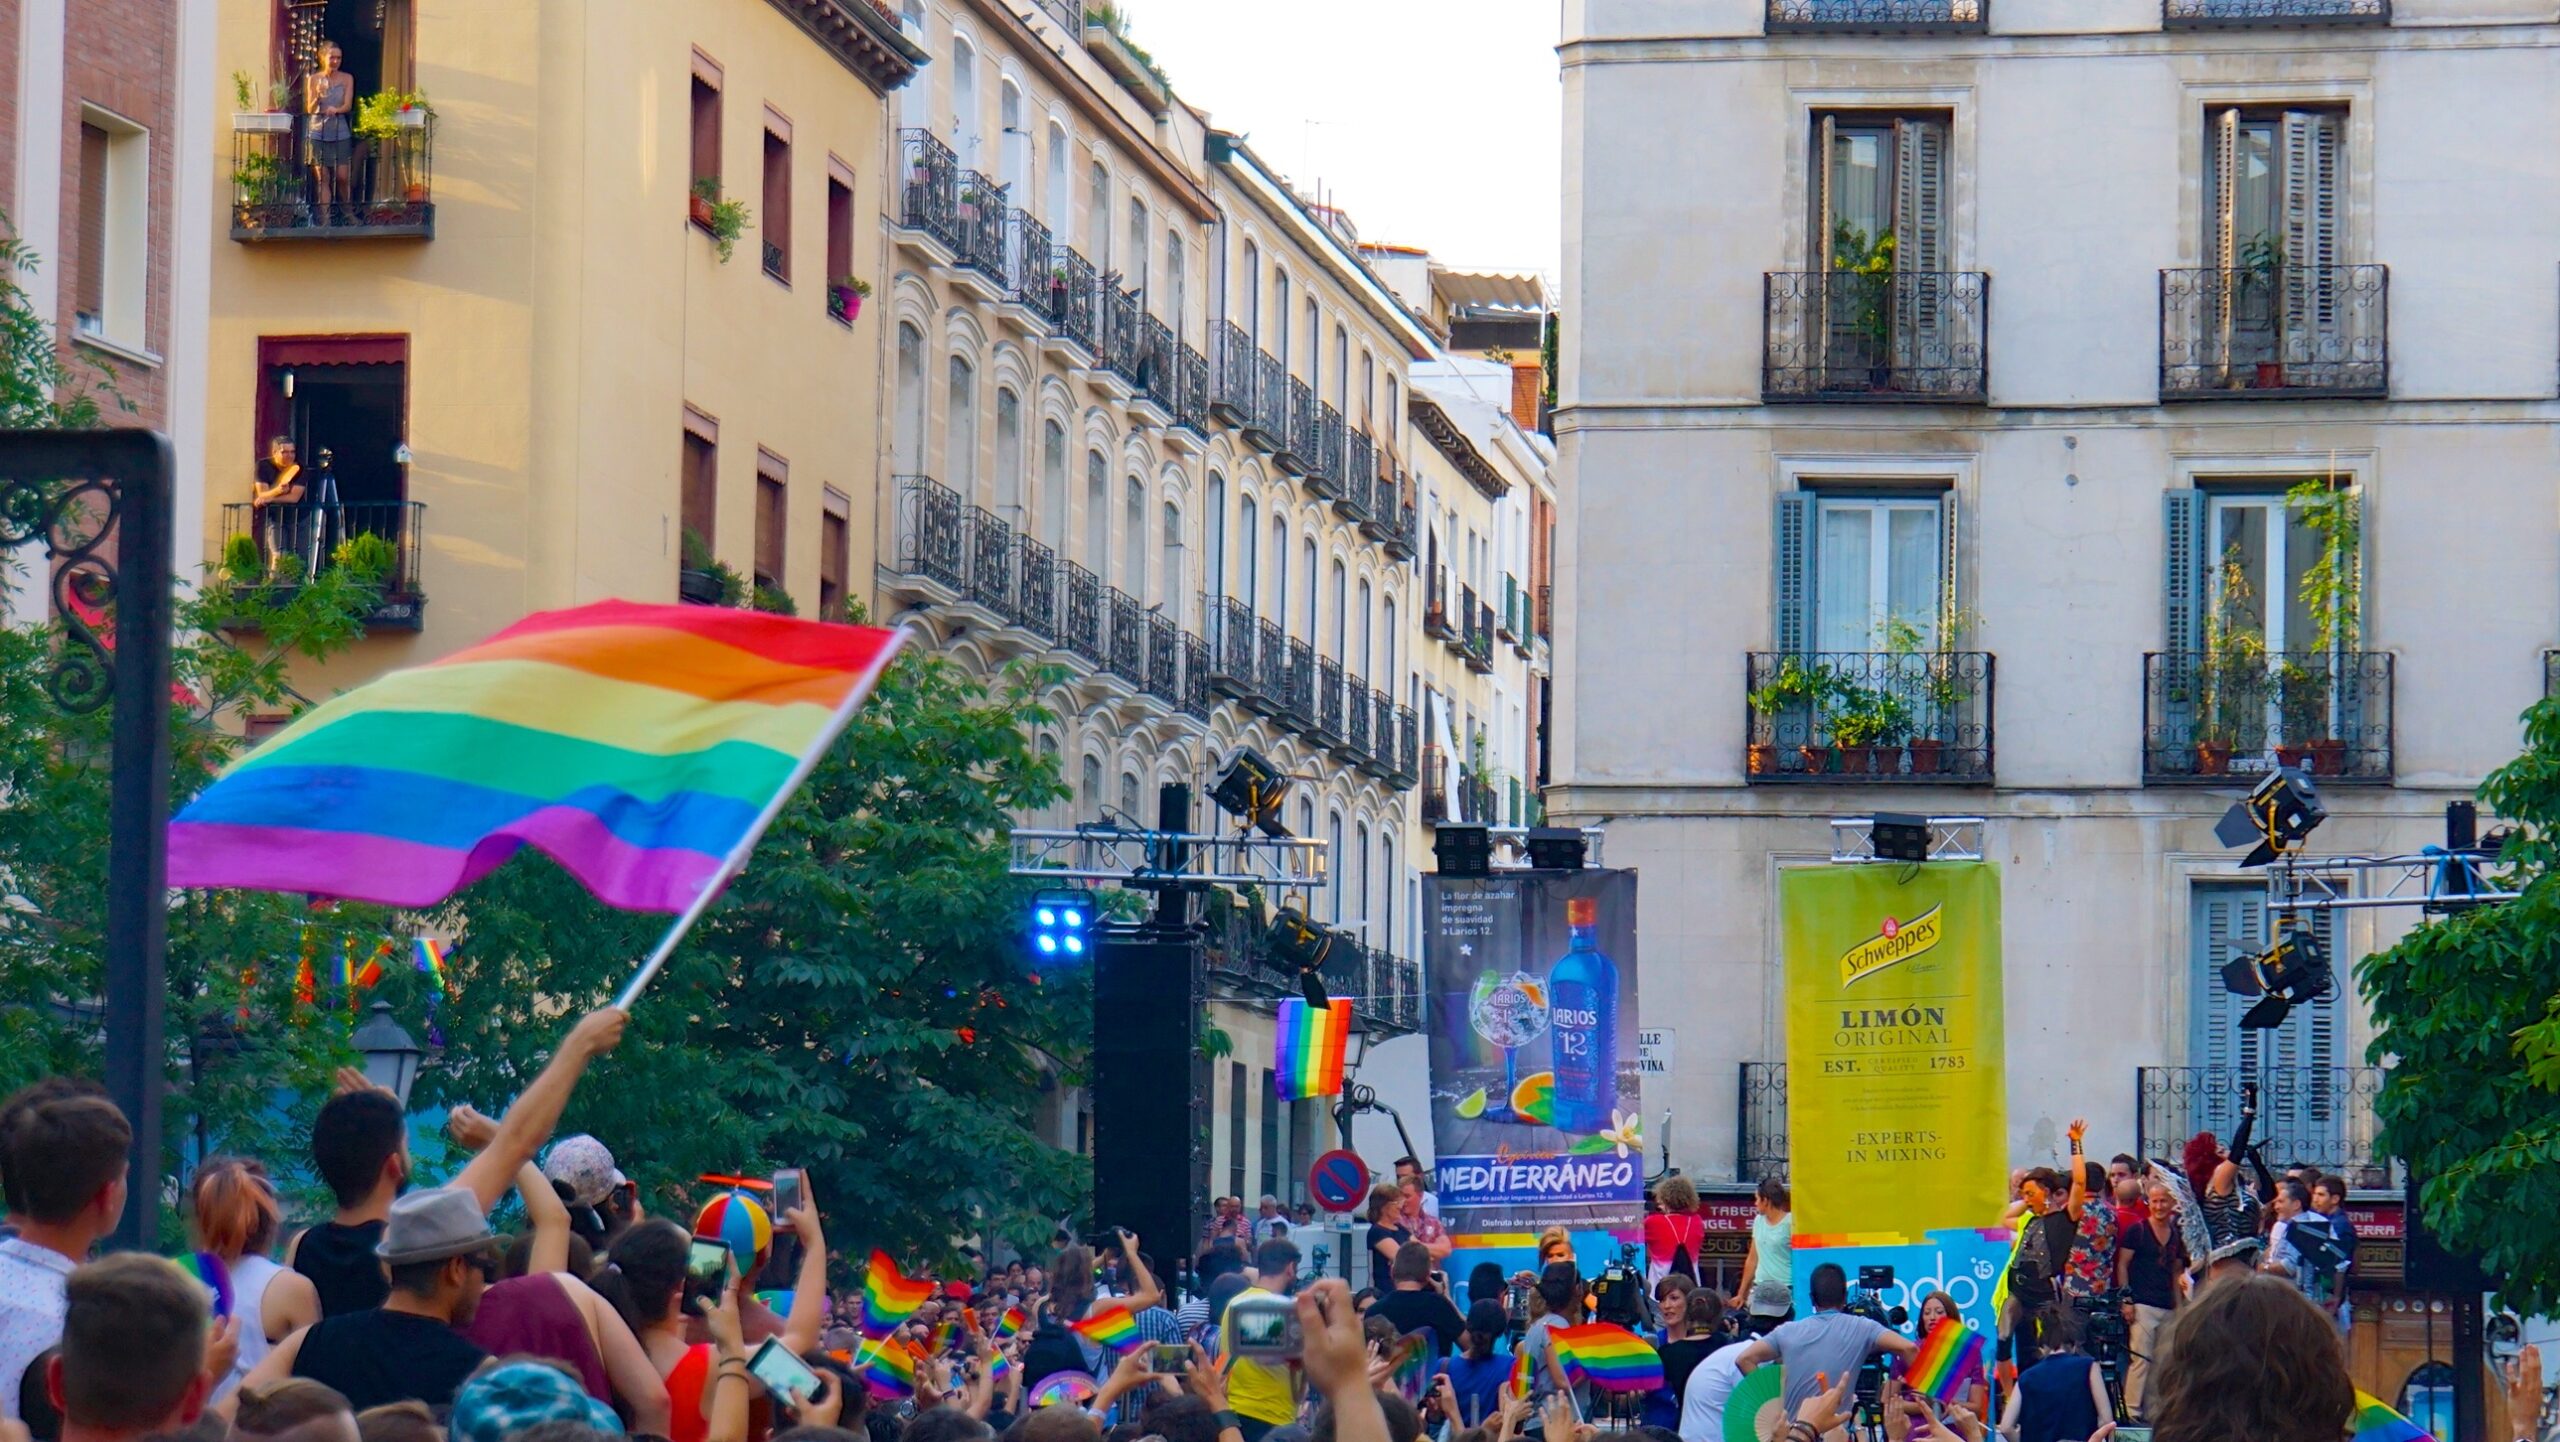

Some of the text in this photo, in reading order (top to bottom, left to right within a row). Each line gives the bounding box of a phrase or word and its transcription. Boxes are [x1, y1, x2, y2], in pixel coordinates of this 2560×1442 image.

[1441, 891, 1452, 900] La
[1472, 891, 1483, 900] de
[1484, 890, 1516, 900] azahar
[1441, 903, 1484, 914] impregna
[1441, 914, 1494, 924] de suavidad
[1450, 926, 1478, 935] Larios
[1847, 919, 1935, 977] Schweppes
[1494, 993, 1526, 1006] LARIOS
[1552, 1007, 1598, 1028] LARIOS
[1840, 1003, 1945, 1029] LIMÓN
[1558, 1032, 1588, 1056] 12
[1640, 1033, 1661, 1045] LLE
[1834, 1028, 1952, 1048] ORIGINAL
[1640, 1060, 1664, 1072] VINA
[1824, 1056, 1966, 1072] EST. 1783
[1847, 1148, 1946, 1162] IN MIXING
[1440, 1157, 1633, 1192] MEDITERRÁNEO
[1710, 1206, 1760, 1216] TABER
[1482, 1218, 1512, 1227] Disfruta
[1514, 1218, 1524, 1226] de
[1536, 1218, 1572, 1226] consumo
[1702, 1218, 1737, 1230] NGEL
[2354, 1224, 2396, 1236] ERRA
